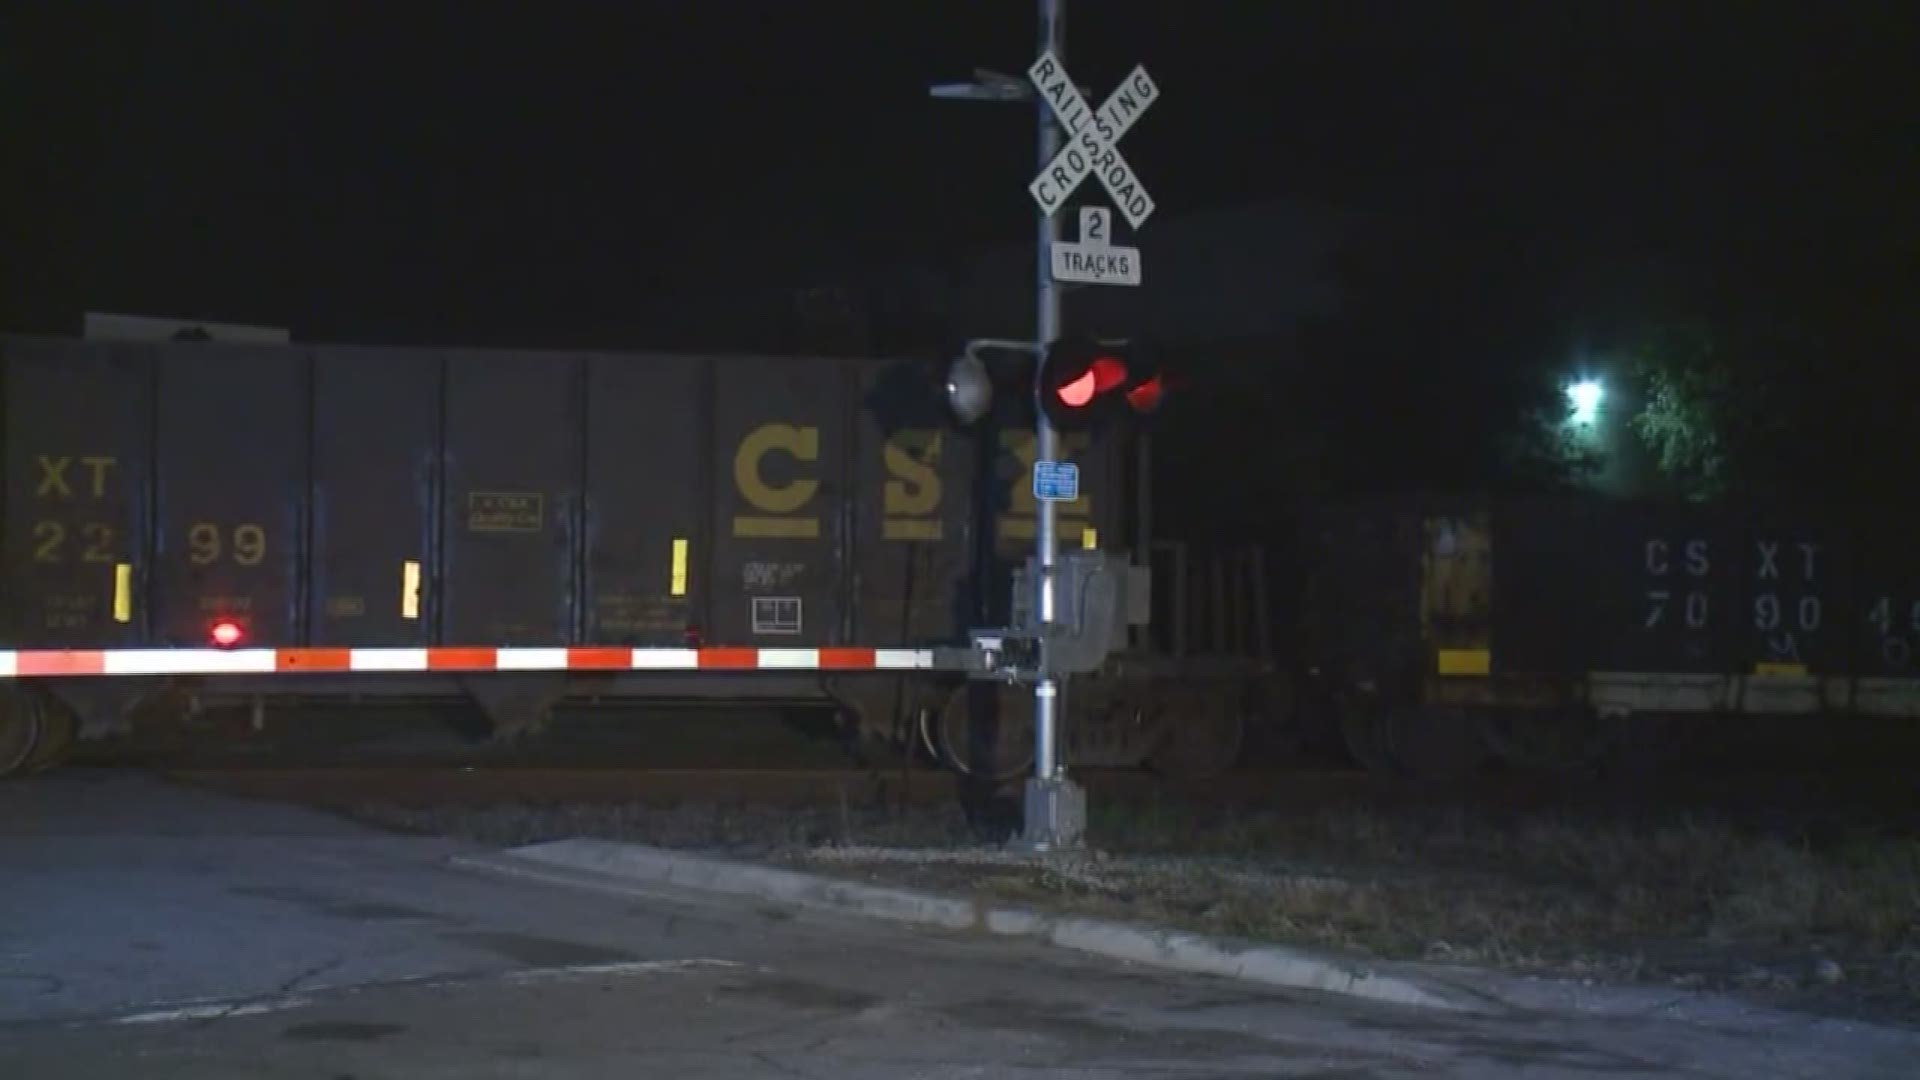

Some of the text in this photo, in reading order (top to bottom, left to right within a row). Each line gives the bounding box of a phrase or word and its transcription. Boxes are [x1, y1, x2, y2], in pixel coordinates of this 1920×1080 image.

[1037, 73, 1152, 207] CROSSING
[1088, 211, 1104, 240] 2
[1063, 251, 1130, 276] TRACKS
